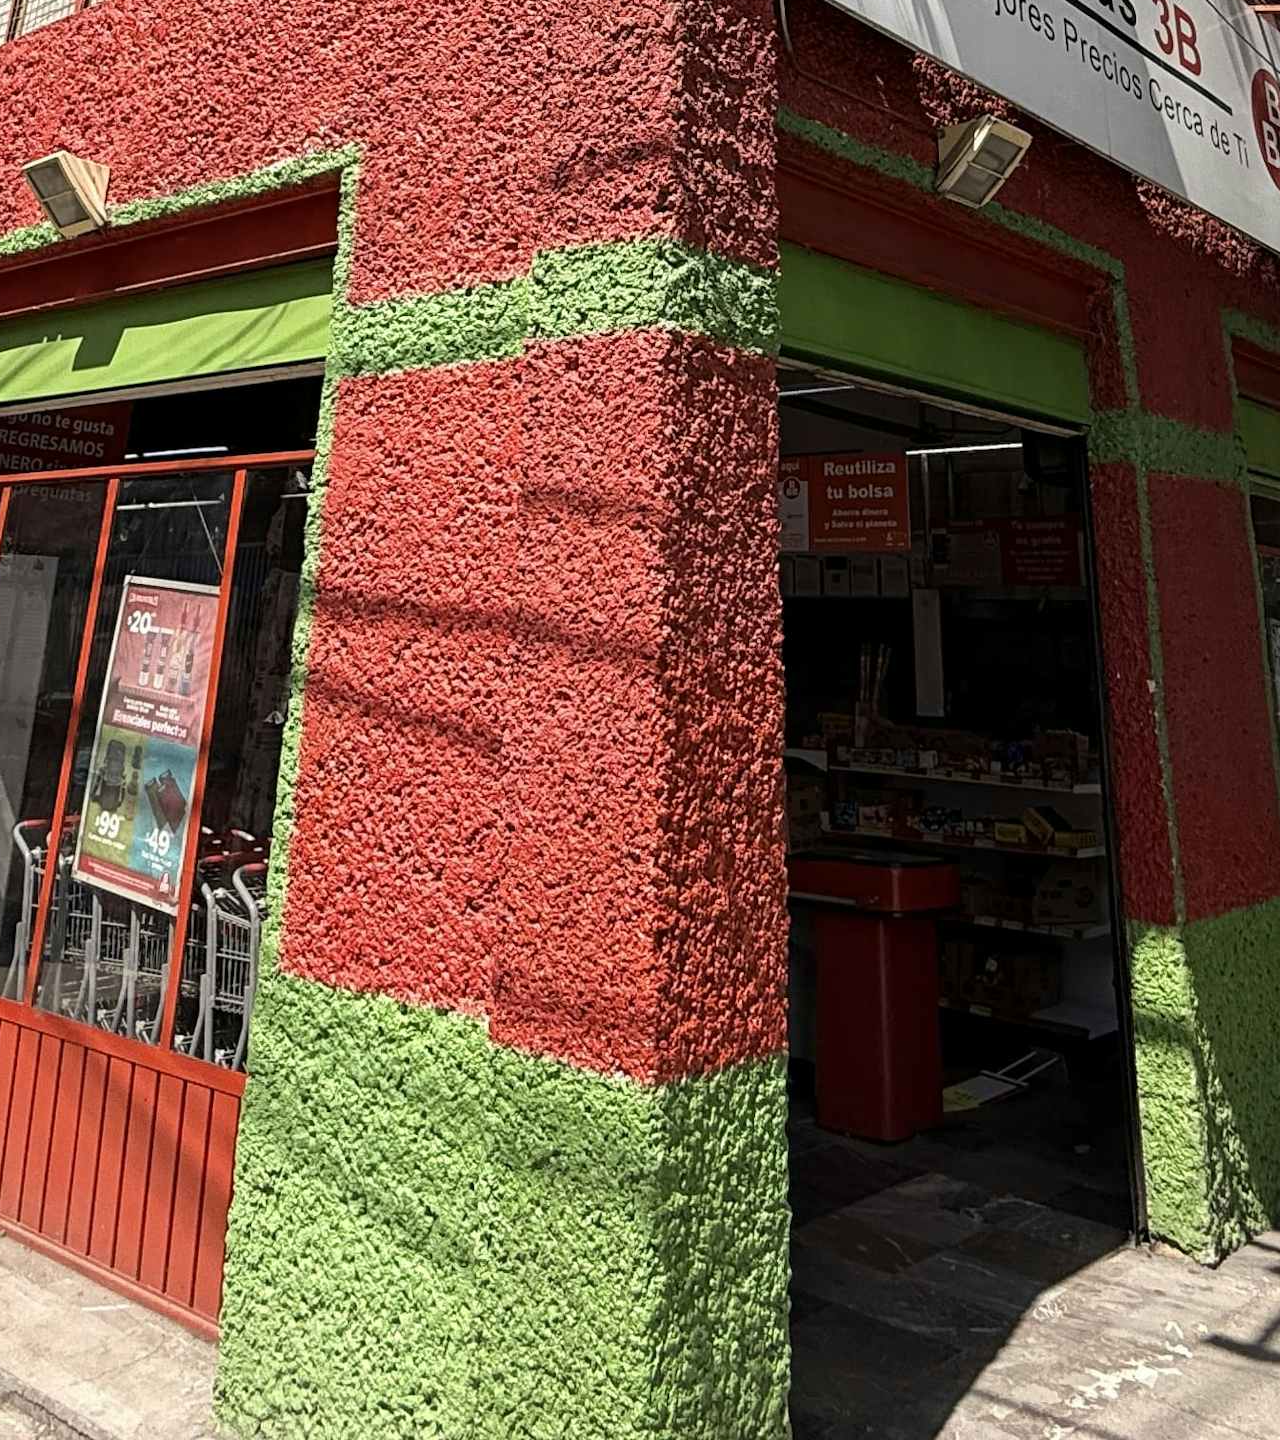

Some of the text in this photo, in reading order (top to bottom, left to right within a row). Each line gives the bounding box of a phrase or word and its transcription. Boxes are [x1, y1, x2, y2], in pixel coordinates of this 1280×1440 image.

[1063, 17, 1142, 100] Precios
[1149, 78, 1204, 136] Cerca
[1210, 120, 1231, 156] de
[1233, 132, 1250, 169] Ti
[30, 415, 52, 426] no
[55, 415, 70, 429] te
[73, 419, 115, 436] gusta
[823, 460, 896, 476] Reutiliza
[826, 484, 894, 499] tu bolsa
